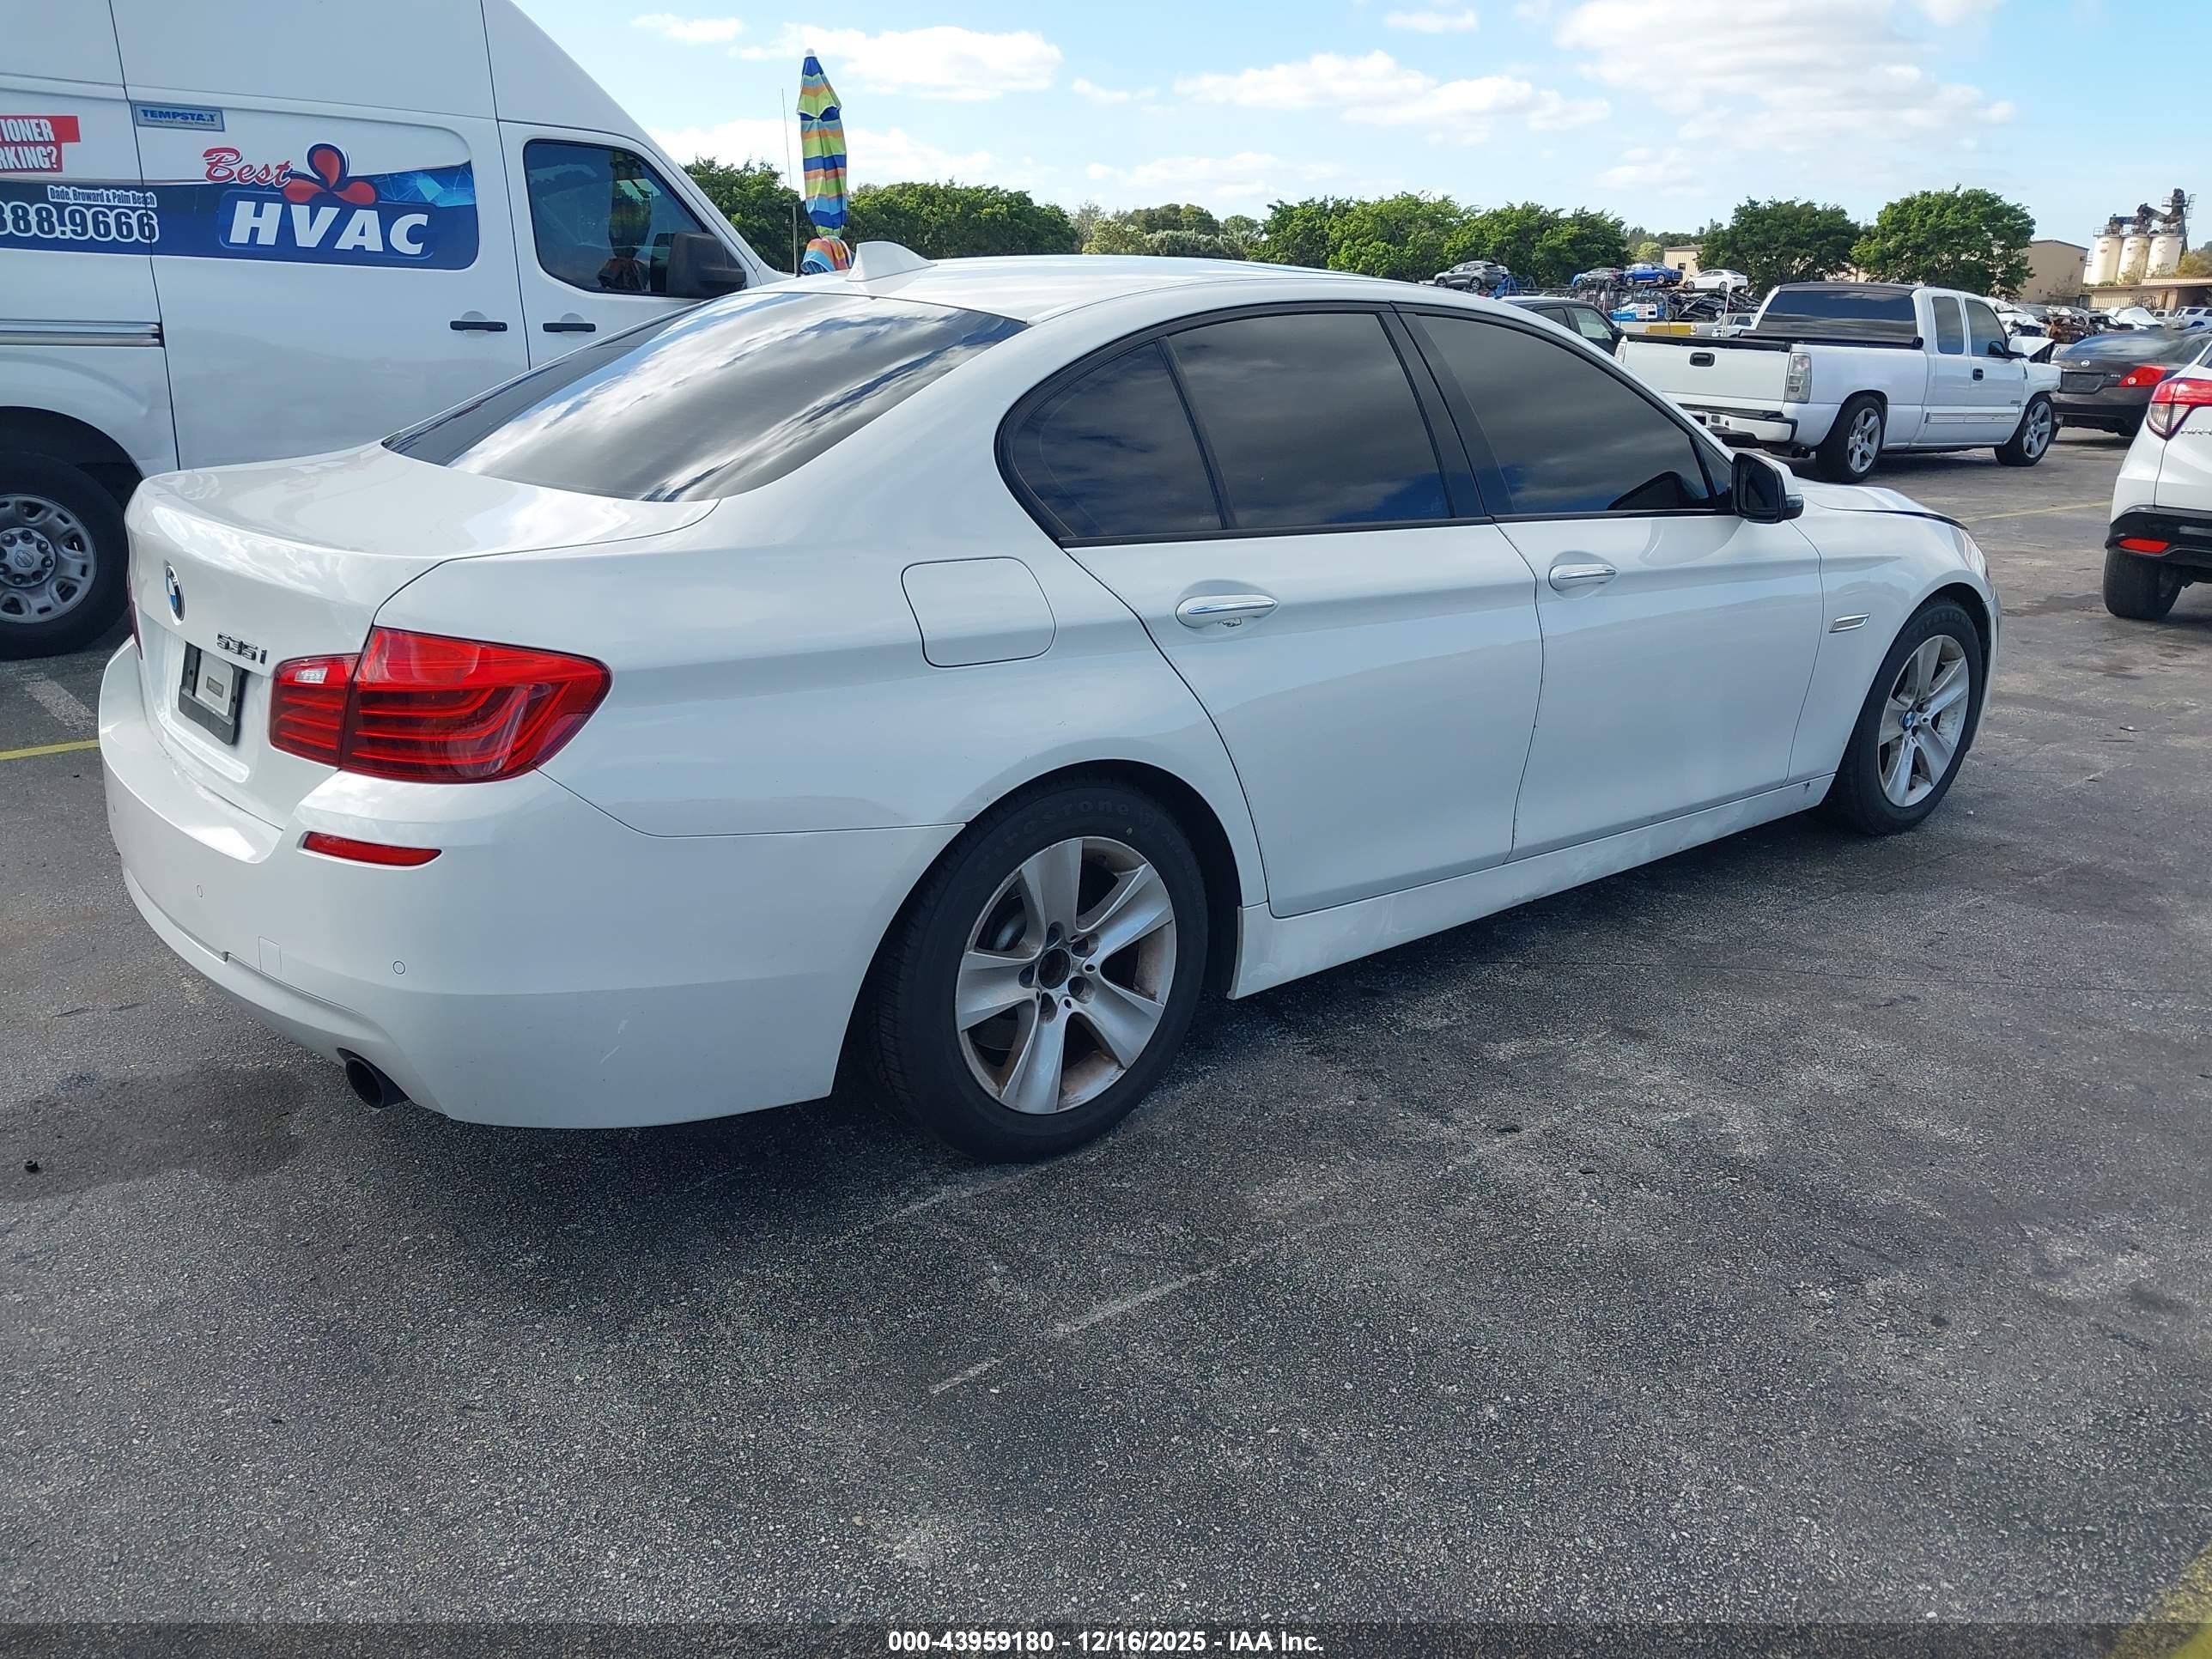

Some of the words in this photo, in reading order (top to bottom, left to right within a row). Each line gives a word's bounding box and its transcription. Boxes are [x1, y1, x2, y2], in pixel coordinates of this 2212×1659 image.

[0, 118, 55, 142] IONER
[203, 147, 295, 186] Best
[50, 186, 72, 203] Dade,
[73, 187, 105, 204] Broward
[112, 190, 131, 205] Palm
[131, 192, 156, 206] Beach
[229, 201, 428, 255] HVAC
[216, 632, 267, 665] 535i
